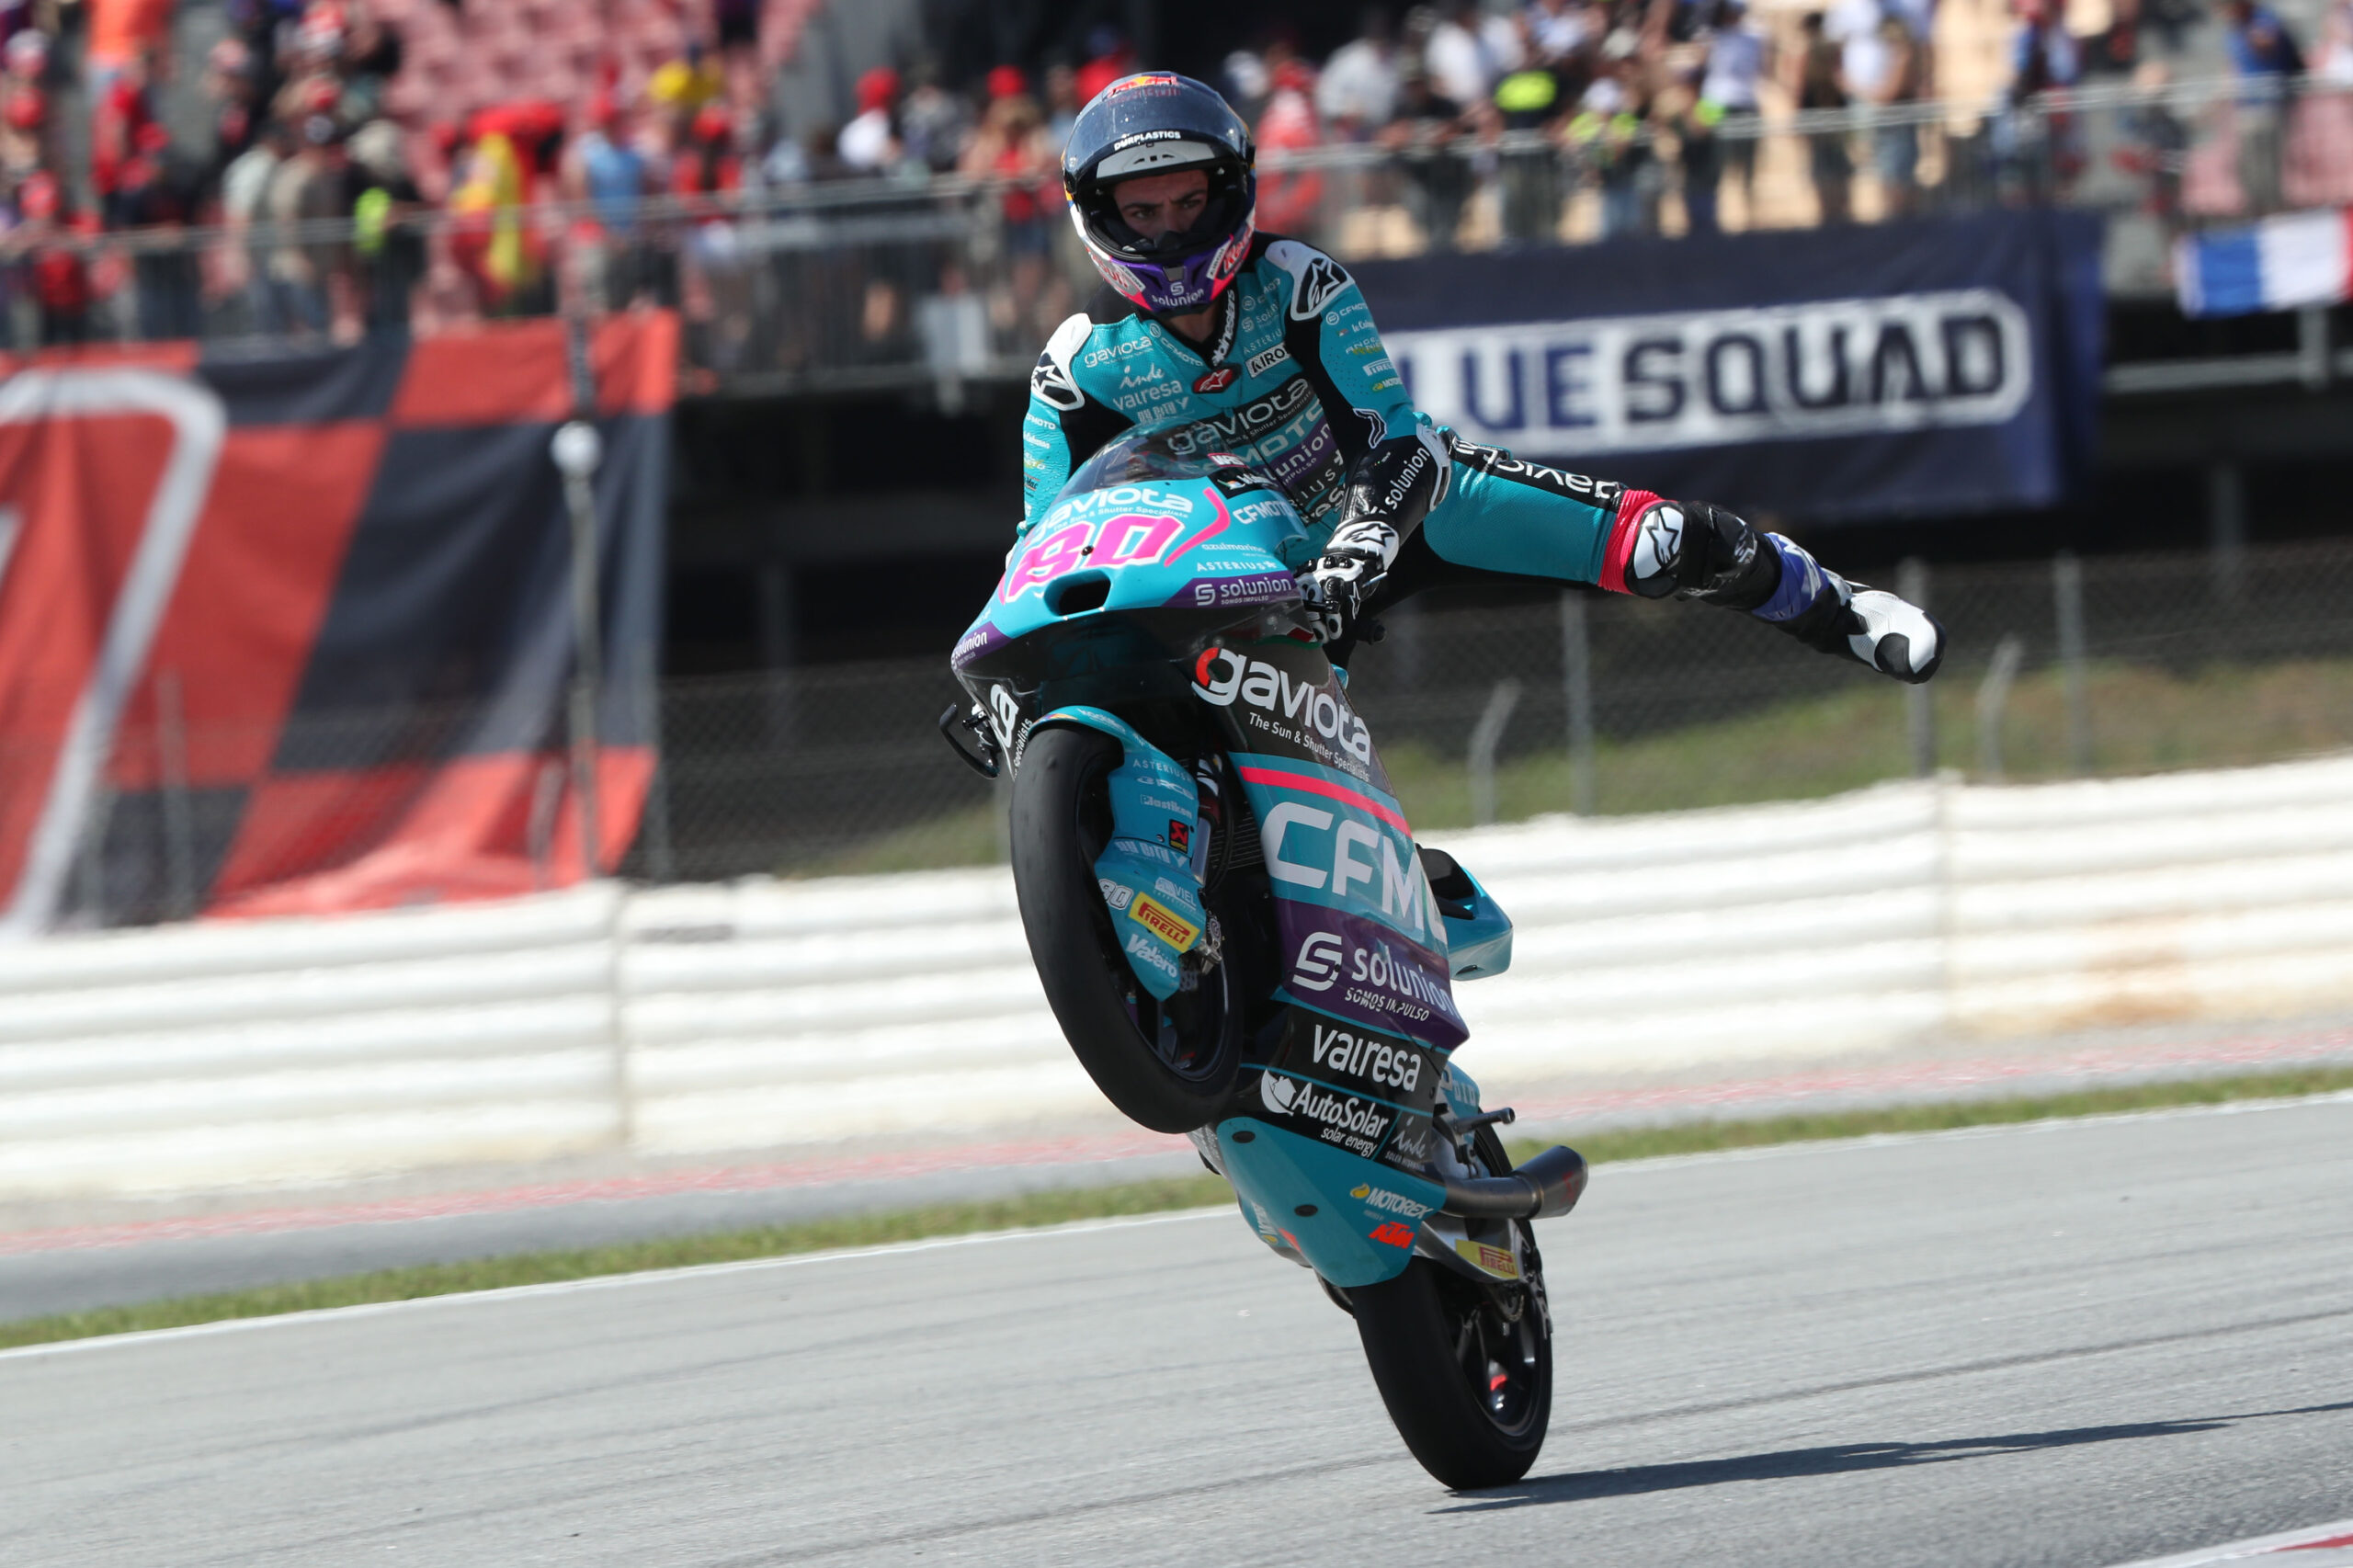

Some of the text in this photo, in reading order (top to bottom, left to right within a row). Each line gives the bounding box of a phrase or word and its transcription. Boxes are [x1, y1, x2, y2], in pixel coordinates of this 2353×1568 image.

[1114, 131, 1181, 151] DURPLASTICS
[1151, 289, 1205, 308] solunion
[1085, 335, 1153, 368] gaviota
[1160, 336, 1205, 367] CFMOTO
[1244, 329, 1283, 356] ASTERIU
[1250, 347, 1287, 374] AIRO
[1167, 378, 1310, 455] gaviota
[1263, 423, 1331, 481] lunion
[1385, 447, 1431, 510] solunion
[1030, 488, 1193, 543] gaviota
[1071, 513, 1087, 523] Sun
[1097, 506, 1133, 516] Shutter
[1135, 506, 1188, 518] Specialists
[1232, 500, 1294, 525] CFMOTO
[1196, 561, 1266, 572] ASTERIUS
[1219, 576, 1292, 597] solunion
[1243, 595, 1269, 603] IMPULSO
[1191, 646, 1371, 767] gaviota
[1249, 711, 1370, 782] The Sun & Shutter Specialists
[1137, 901, 1191, 945] PIRELLI
[1351, 946, 1463, 1021] solunion
[1345, 987, 1385, 1013] SOMOS
[1313, 1024, 1422, 1092] valresa
[1290, 1082, 1389, 1139] AutoSolar
[1320, 1126, 1378, 1159] solar energy
[1365, 1187, 1434, 1220] MOTOREX
[1368, 1221, 1415, 1249] KTM
[1478, 1245, 1517, 1276] PIRELLI
